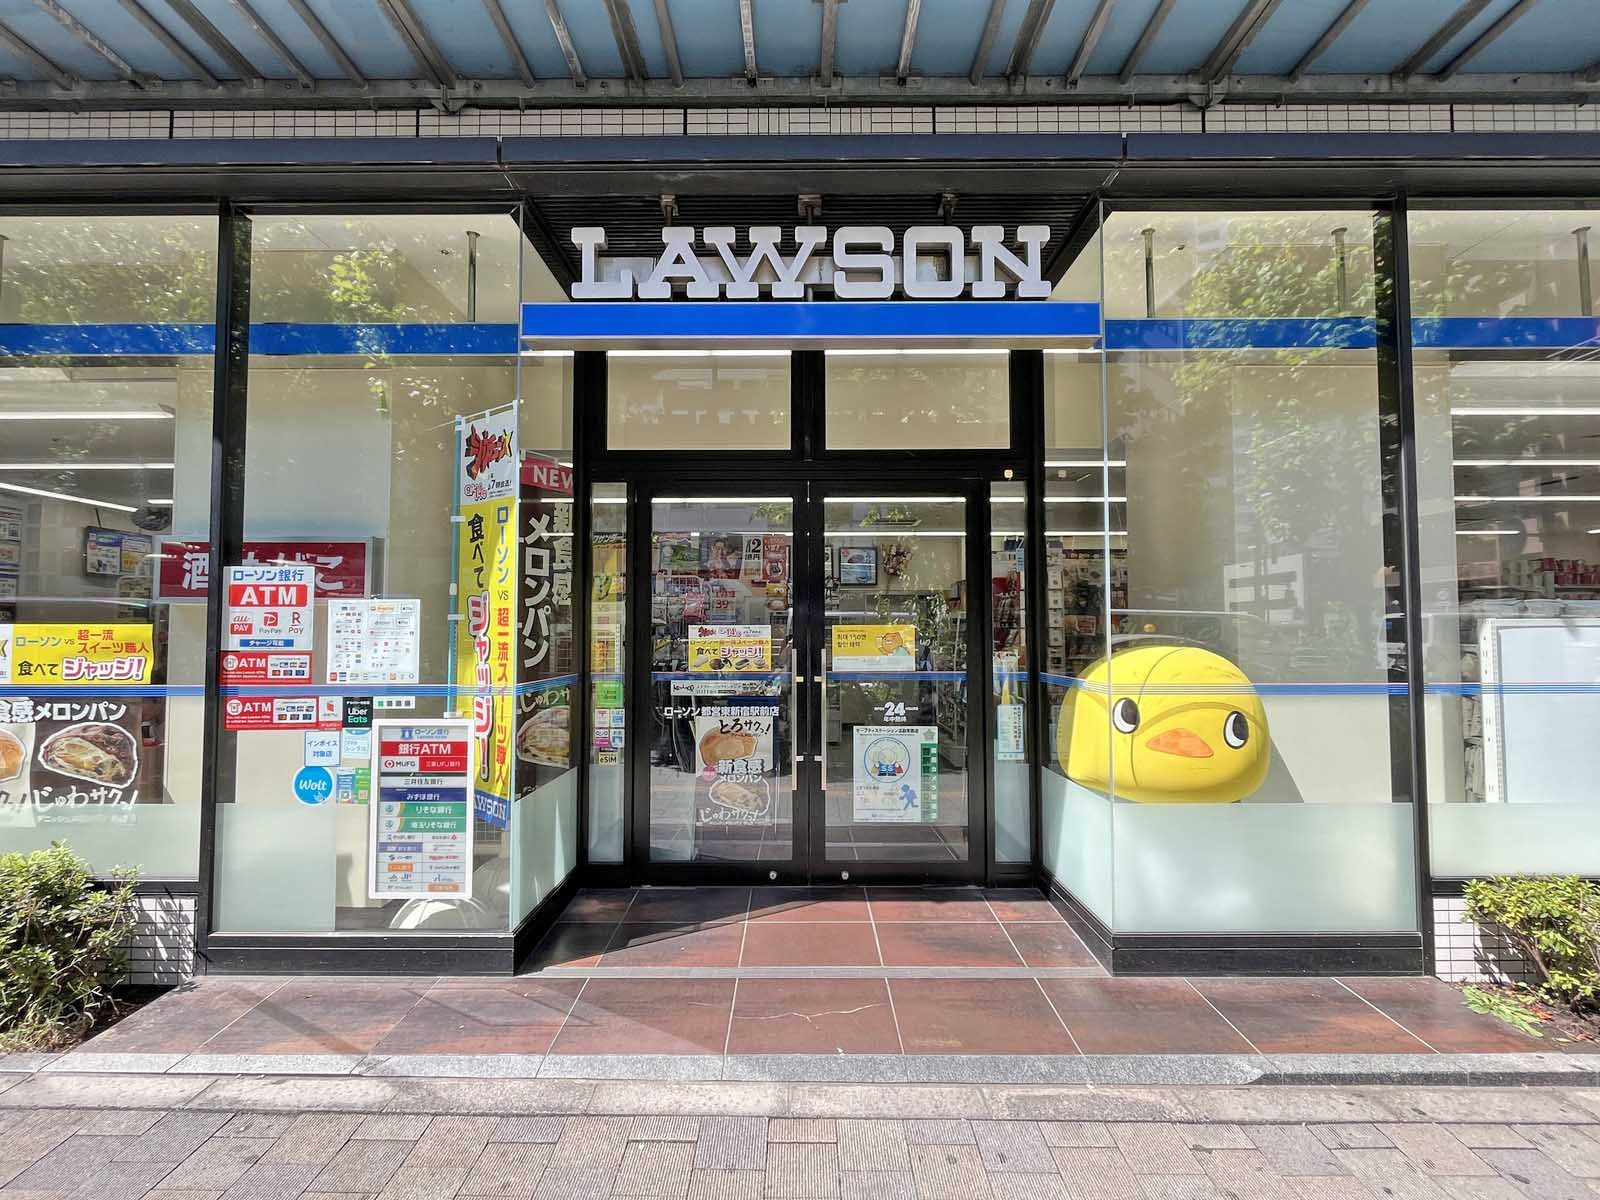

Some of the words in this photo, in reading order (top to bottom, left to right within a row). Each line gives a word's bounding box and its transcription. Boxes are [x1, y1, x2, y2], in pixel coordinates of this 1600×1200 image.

[571, 225, 1051, 299] LAWSON
[467, 513, 485, 588] 食べて
[497, 506, 509, 584] ローソン
[232, 568, 305, 582] ローソン銀行
[240, 586, 298, 605] ATM
[522, 513, 552, 669] メロンパン
[233, 624, 249, 632] PAY
[288, 627, 304, 635] Pay
[77, 629, 114, 641] 超一流
[15, 636, 62, 647] ローソン
[77, 642, 150, 654] スイーツ職人
[17, 660, 58, 676] 食べて
[62, 656, 146, 681] ジャッジ!
[238, 657, 267, 668] ATM
[243, 701, 272, 713] ATM
[347, 707, 368, 715] Uber
[884, 702, 906, 716] 24
[347, 715, 368, 723] Eats
[719, 718, 771, 735] とろサクっ!
[398, 743, 451, 755] 銀行ATM
[600, 756, 617, 764] eSIM
[299, 779, 327, 791] Wolt
